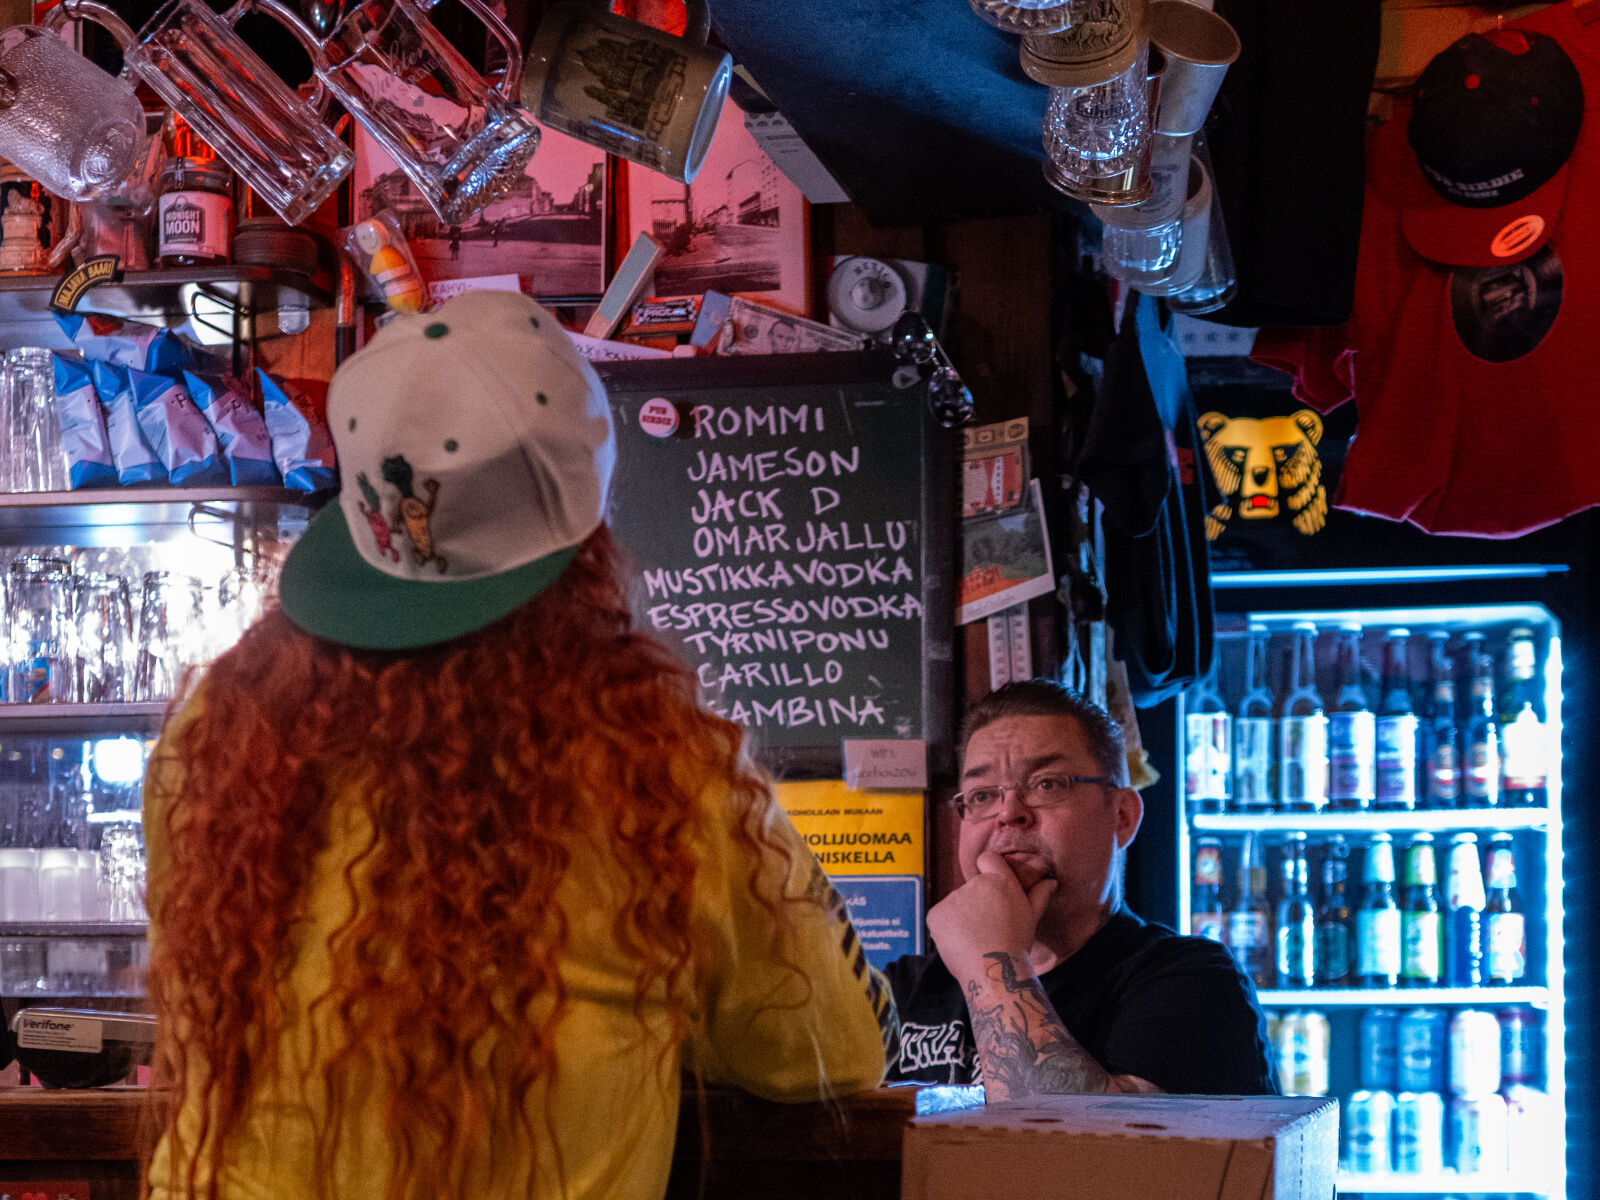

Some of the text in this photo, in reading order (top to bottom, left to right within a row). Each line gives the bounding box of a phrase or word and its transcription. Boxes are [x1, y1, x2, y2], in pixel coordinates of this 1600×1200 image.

[165, 220, 200, 235] MOON
[690, 404, 825, 440] ROMMI
[687, 446, 859, 483] JAMESON
[691, 486, 841, 524] JACK D
[693, 520, 907, 558] OMAR JALLU
[643, 556, 914, 599] MUSTIKKAVODKA
[647, 592, 924, 630] ESPRESSOVODKA
[682, 627, 890, 656] TYRNIPONU
[697, 659, 844, 692] CARILLO
[804, 832, 913, 846] OLIJUOMAA
[815, 850, 896, 864] NISKELLA
[23, 1018, 72, 1031] Verifone
